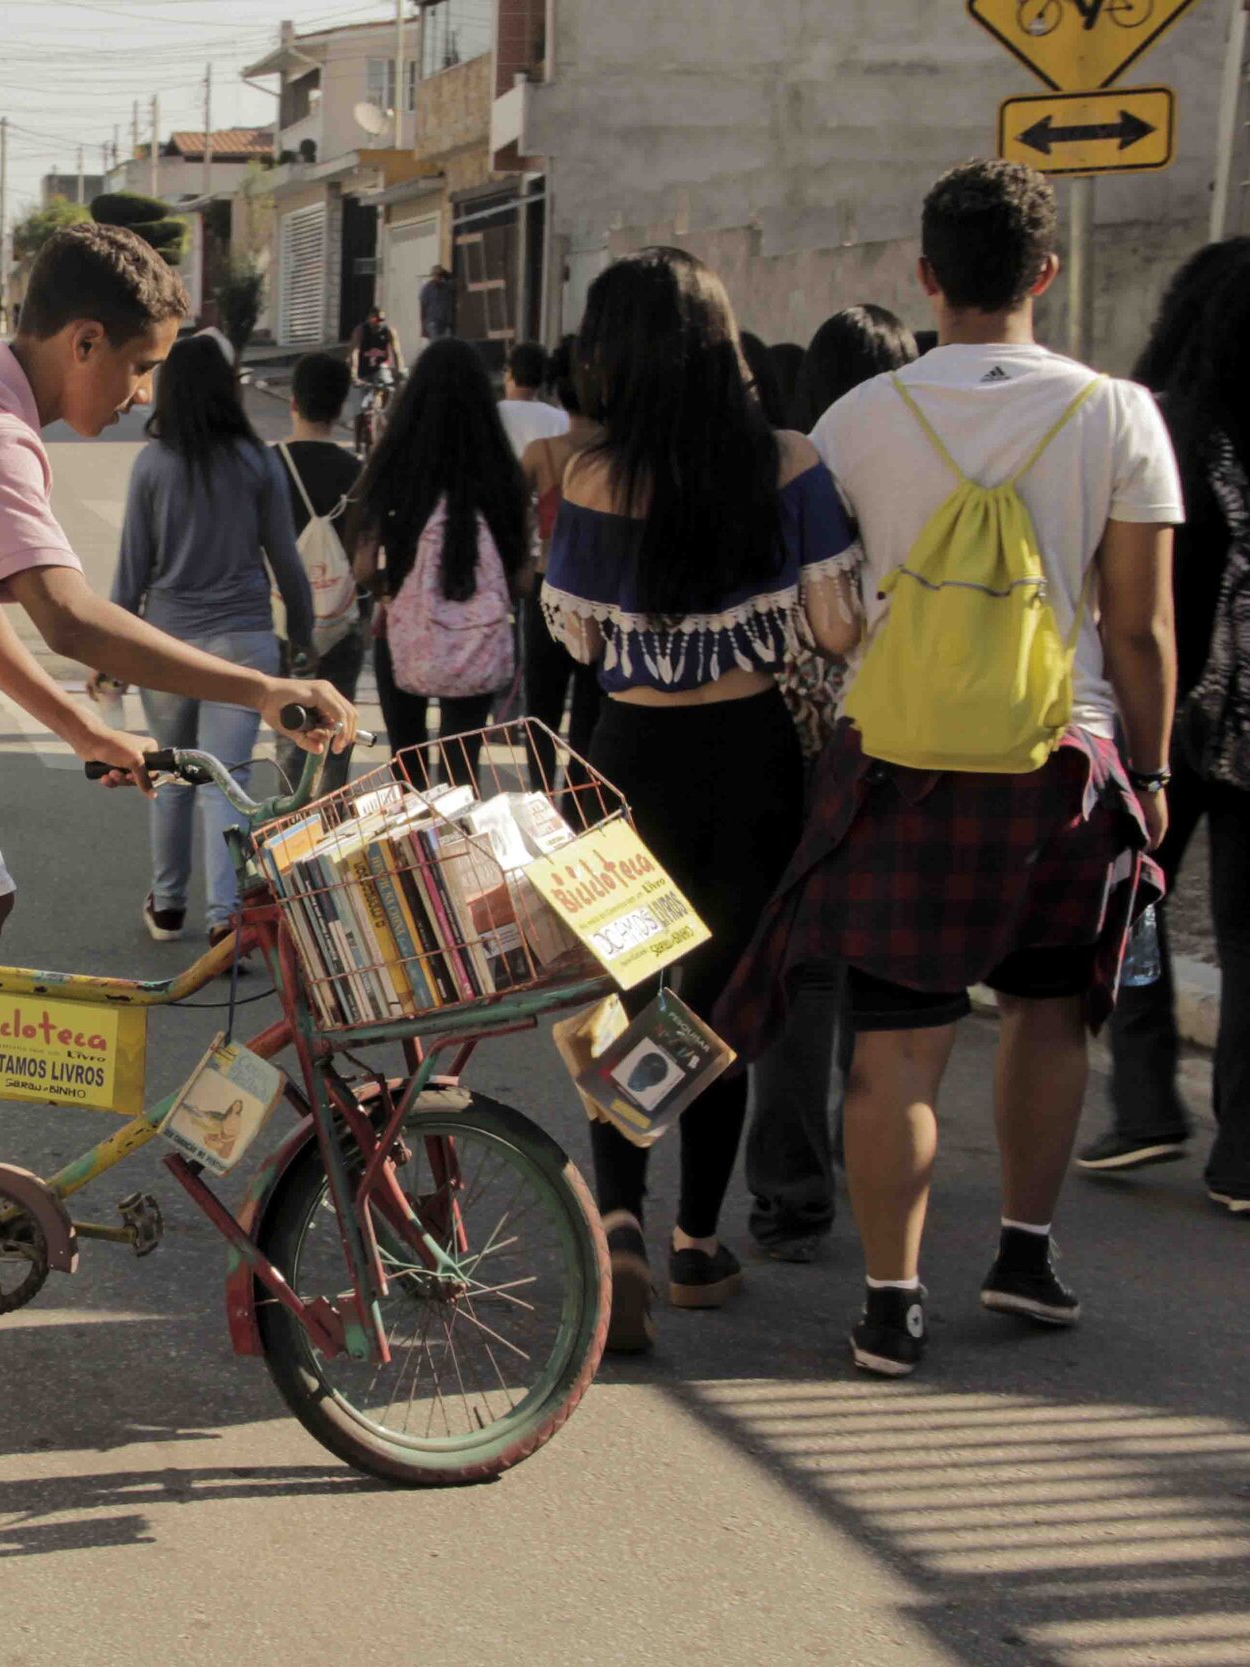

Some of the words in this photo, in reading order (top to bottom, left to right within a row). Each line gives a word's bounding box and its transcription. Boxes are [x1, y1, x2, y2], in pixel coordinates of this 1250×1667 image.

[549, 849, 655, 914] Bicicloteca
[649, 892, 689, 928] LIVROS
[67, 1050, 106, 1063] Livro
[51, 1060, 105, 1087] LIVROS
